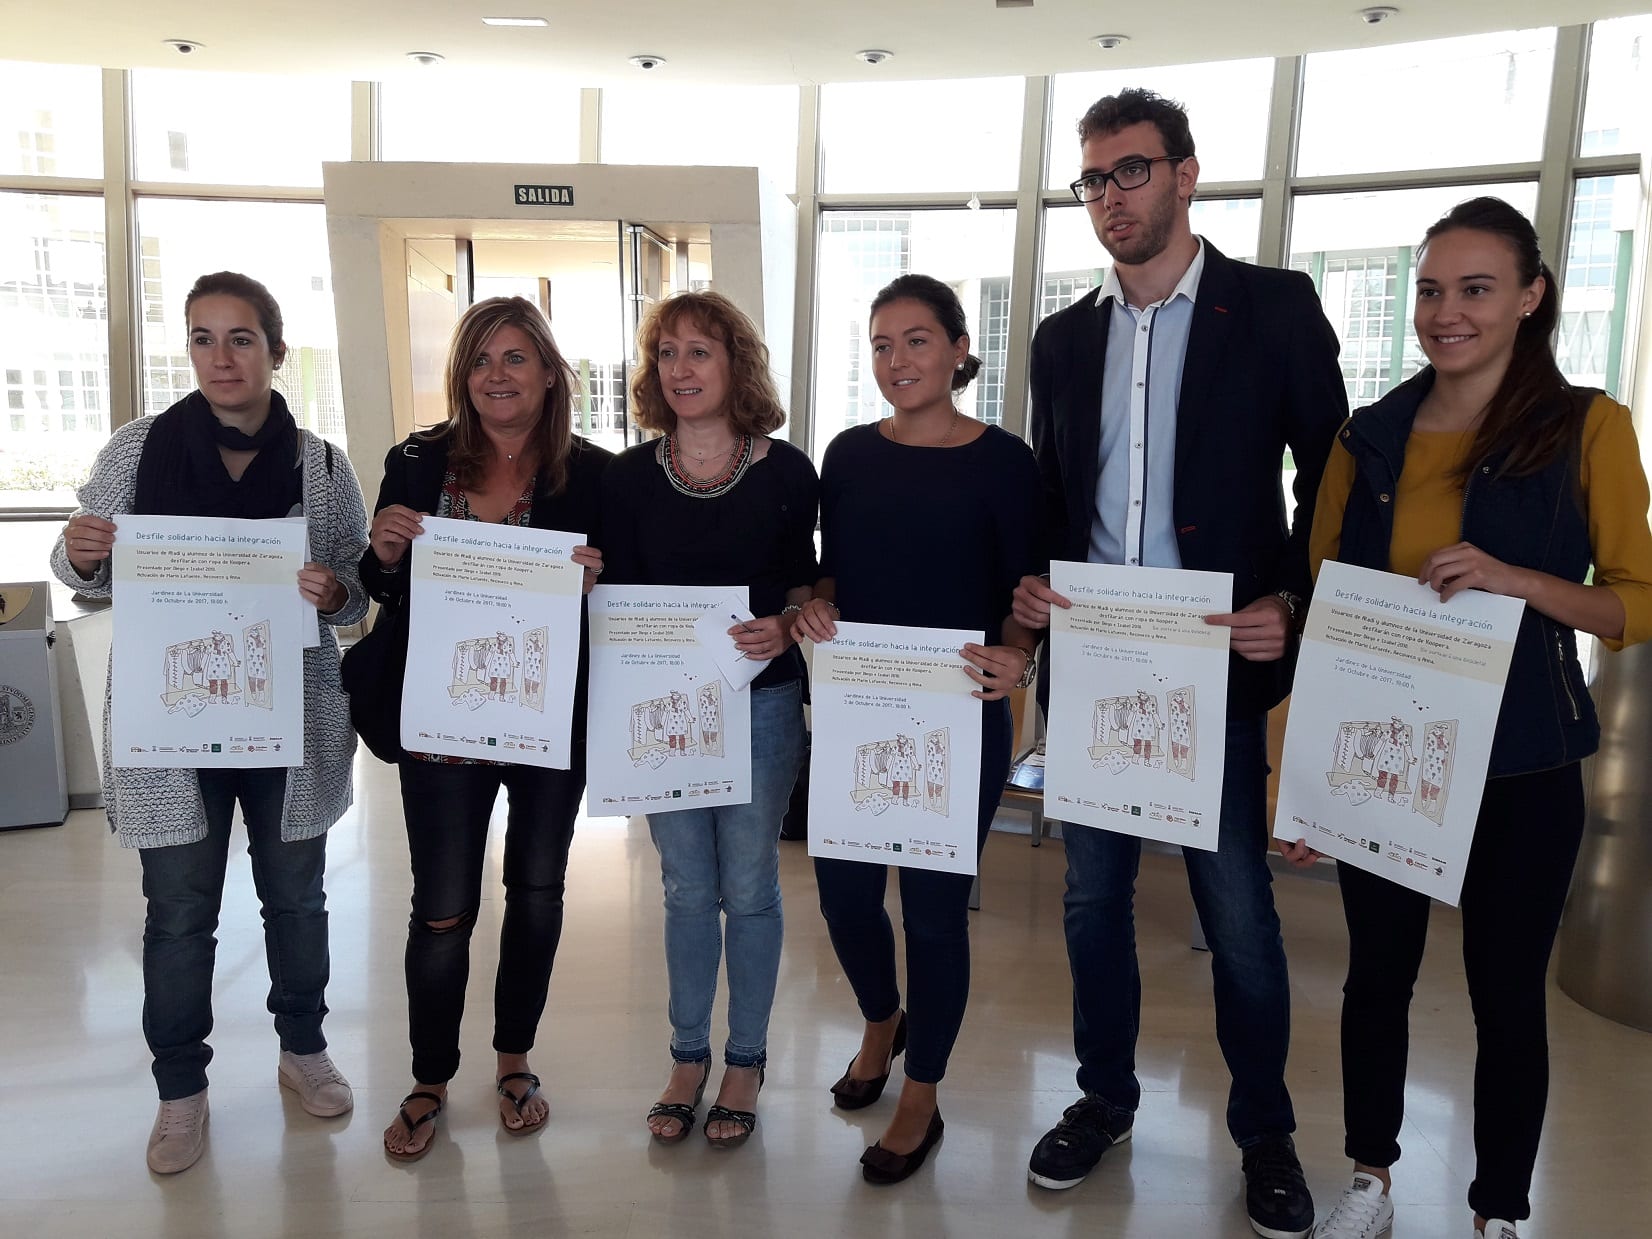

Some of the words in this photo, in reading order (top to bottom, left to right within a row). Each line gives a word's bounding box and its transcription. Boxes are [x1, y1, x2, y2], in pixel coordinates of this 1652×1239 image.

[518, 187, 570, 203] SALIDA
[136, 532, 164, 540] Desfile
[238, 536, 281, 544] integración
[434, 534, 458, 543] Desfile
[461, 538, 491, 546] solidario
[494, 541, 512, 549] hacia
[523, 544, 562, 555] integración
[1070, 585, 1094, 594] Desfile
[1097, 588, 1129, 596] solidario
[1132, 590, 1152, 598] hacia
[1165, 593, 1210, 604] integración
[1336, 590, 1362, 602] Desfile
[1365, 598, 1400, 610] solidario
[1403, 605, 1426, 616] hacia
[1429, 610, 1436, 618] la
[1440, 612, 1492, 630] integración
[920, 645, 960, 655] integración
